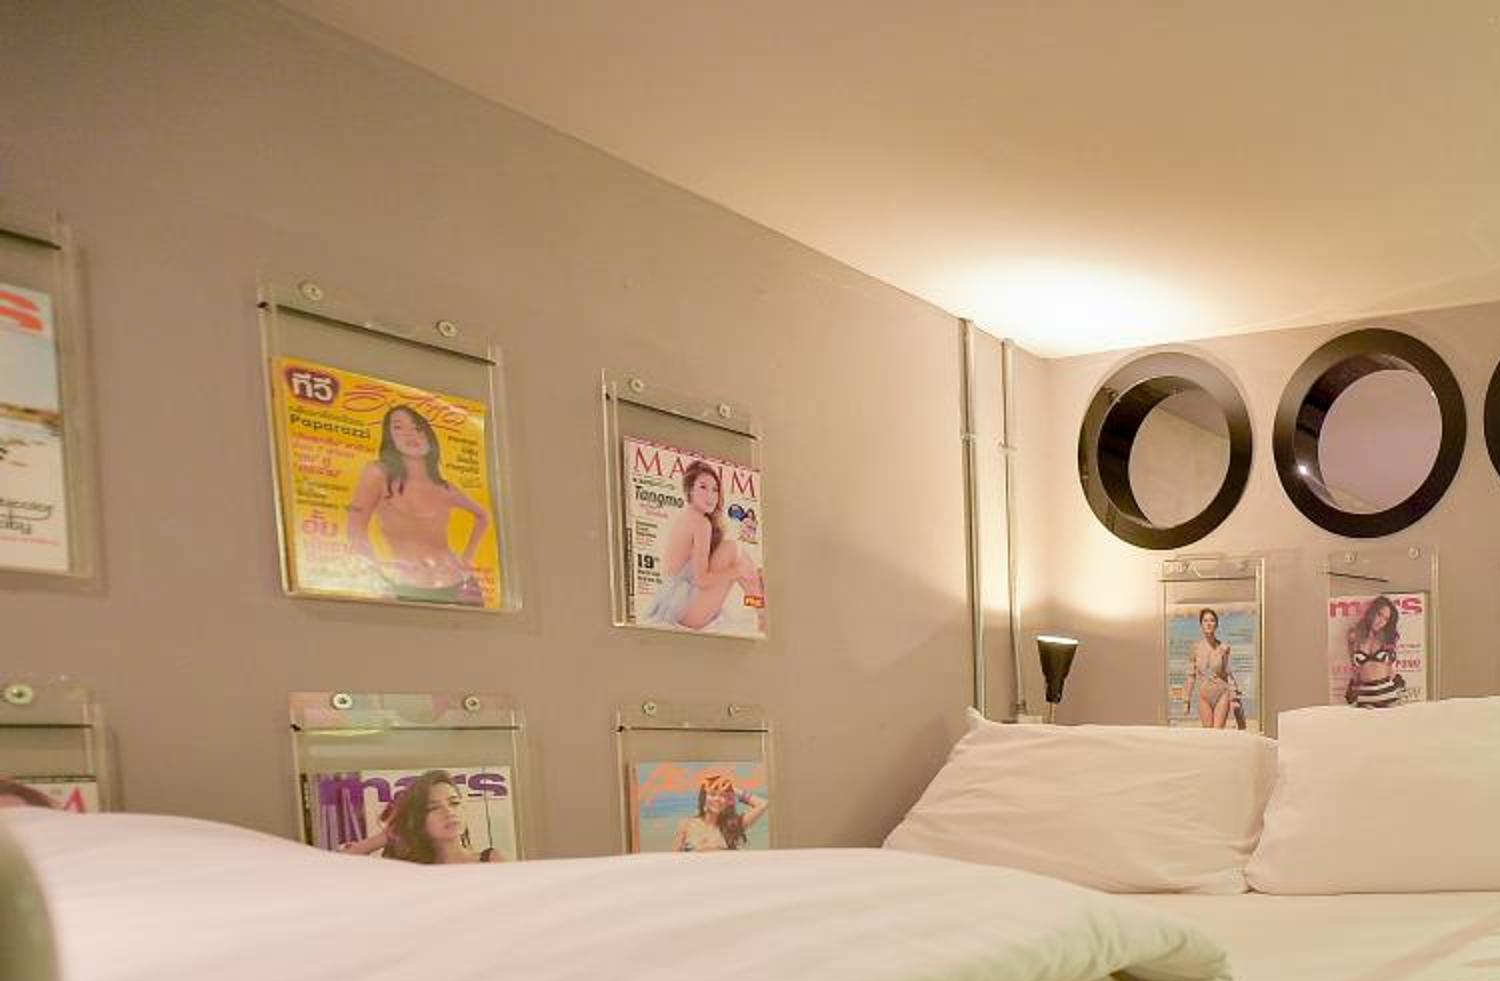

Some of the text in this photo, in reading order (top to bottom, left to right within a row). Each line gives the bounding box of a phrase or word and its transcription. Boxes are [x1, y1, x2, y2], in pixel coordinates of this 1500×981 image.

[289, 411, 371, 439] Paparazzi
[634, 447, 756, 498] MAIM
[635, 484, 684, 509] Tangmo
[1329, 597, 1422, 617] ms
